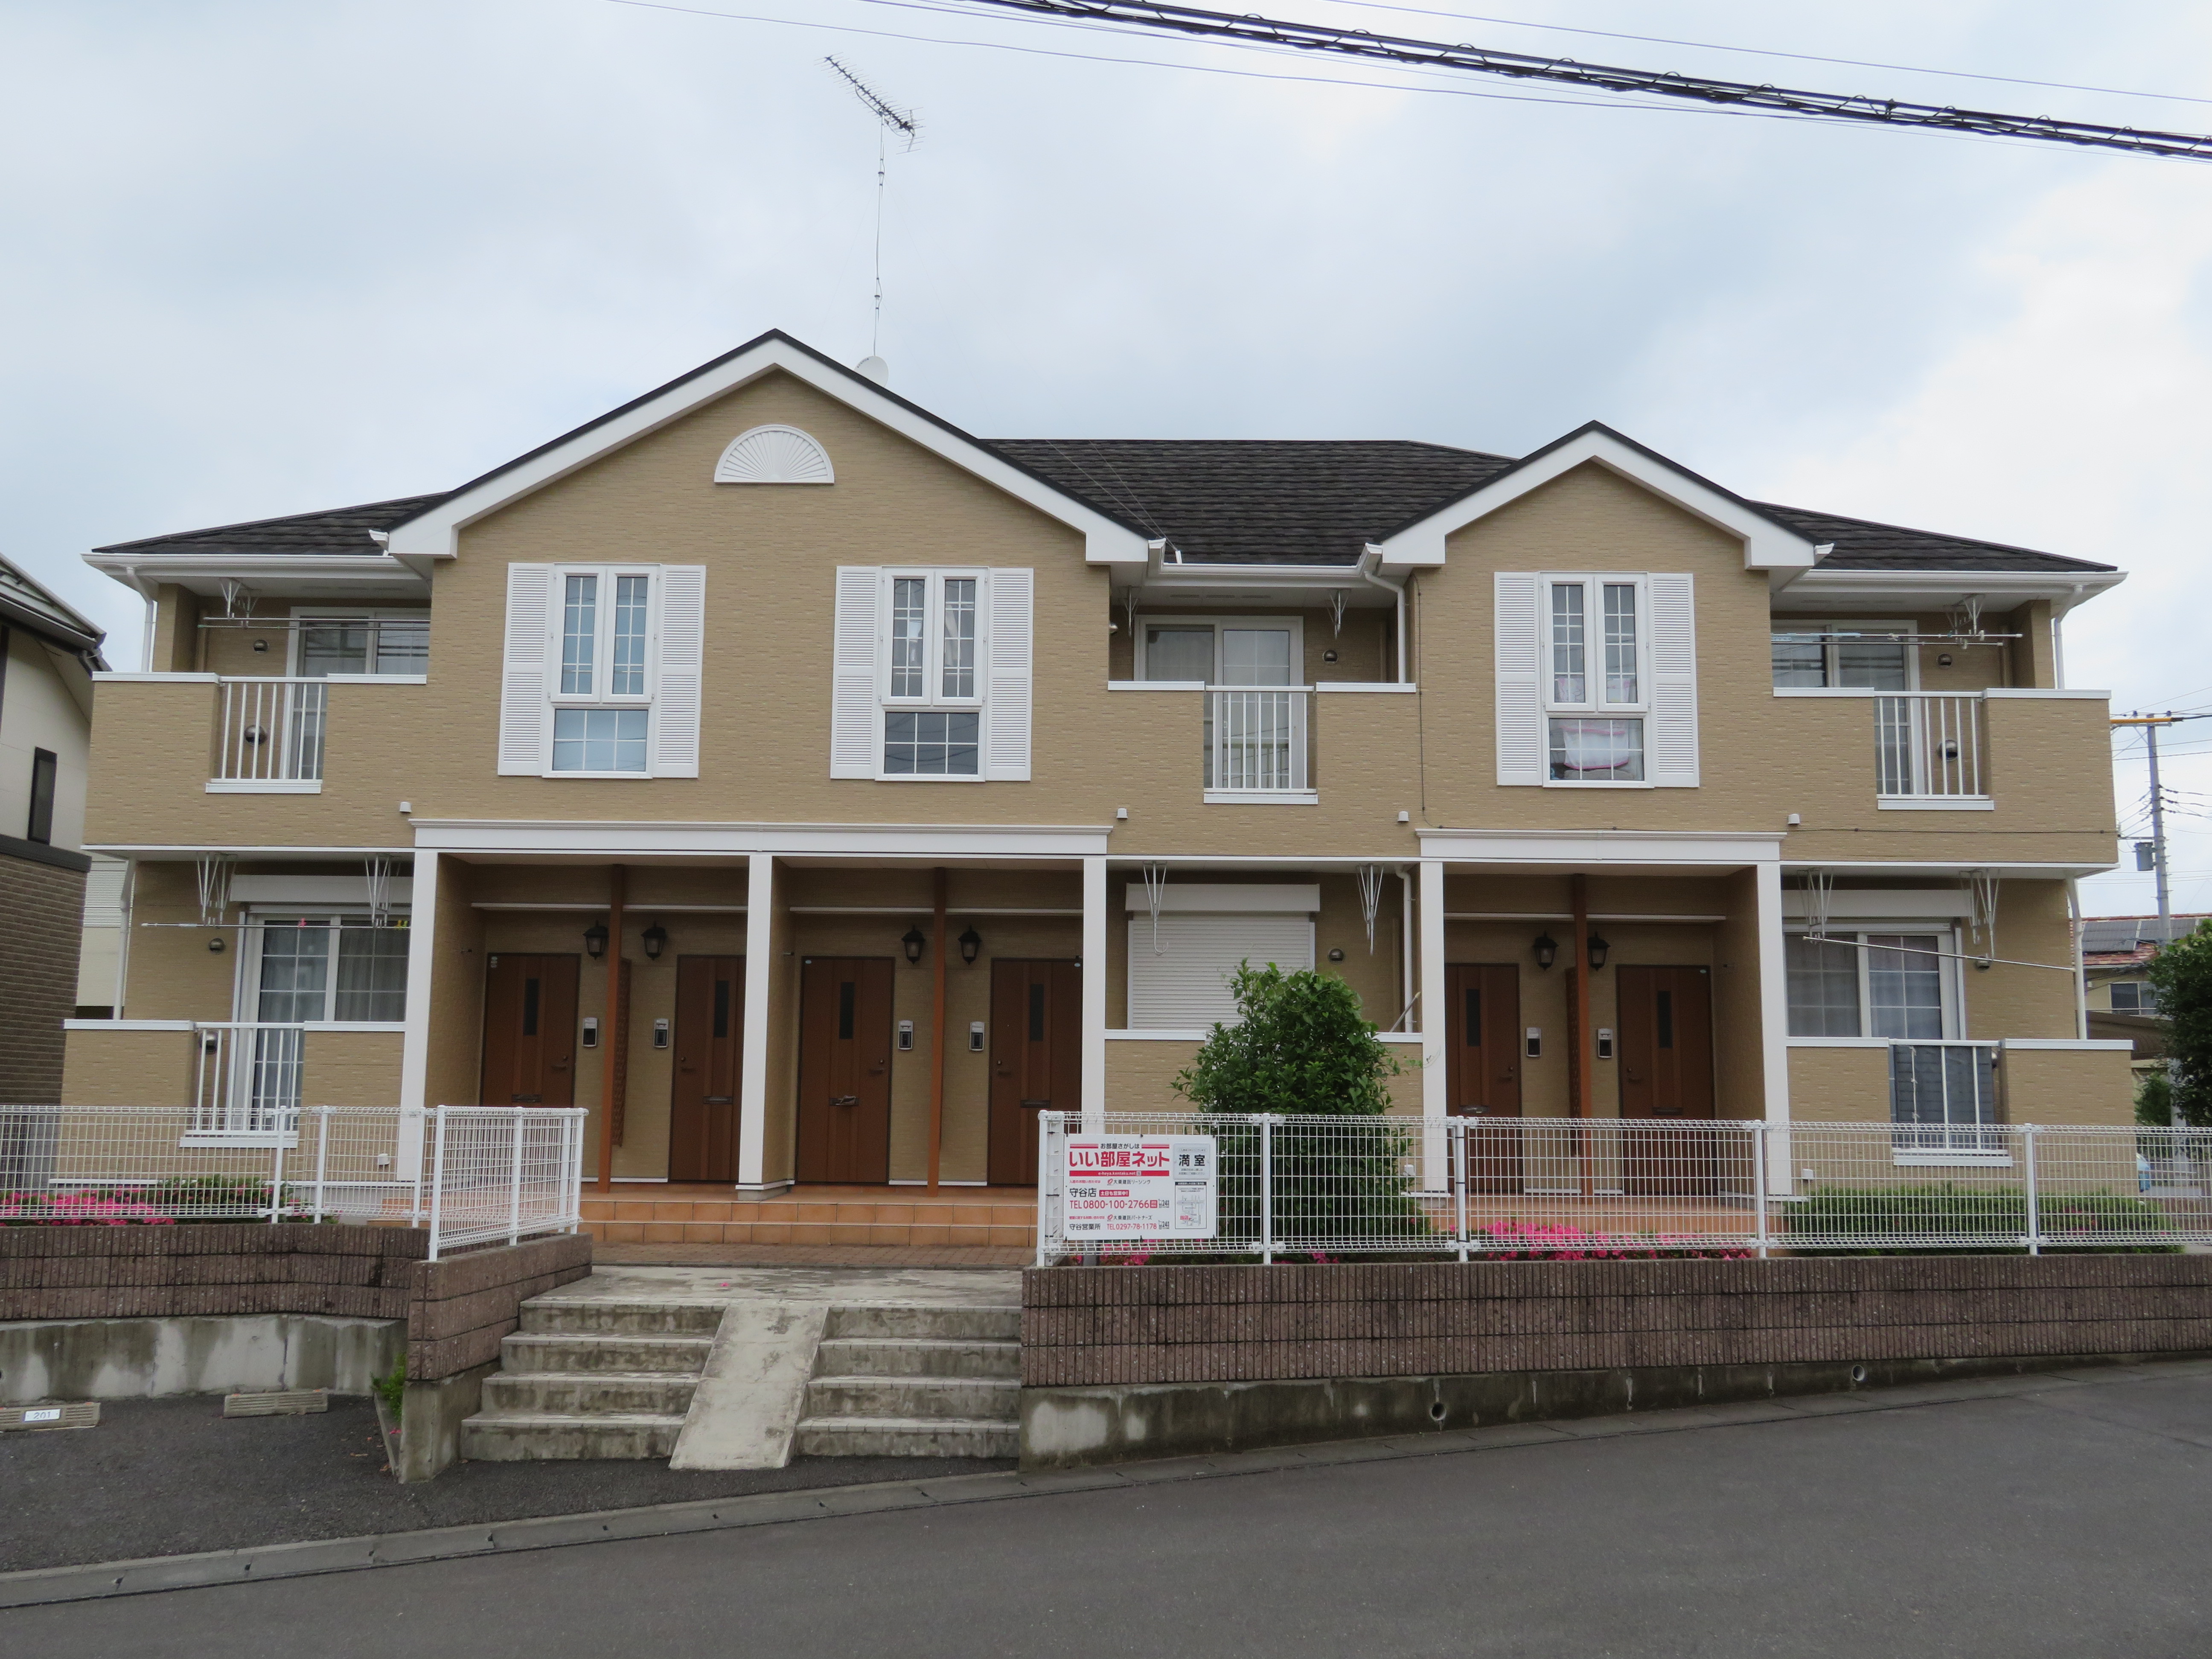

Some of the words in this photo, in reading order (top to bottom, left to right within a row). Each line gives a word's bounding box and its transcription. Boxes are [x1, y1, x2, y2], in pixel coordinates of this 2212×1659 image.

[1069, 1151, 1170, 1167] いい部屋ネット
[1069, 1188, 1097, 1197] 守谷店
[34, 1411, 51, 1419] 201
